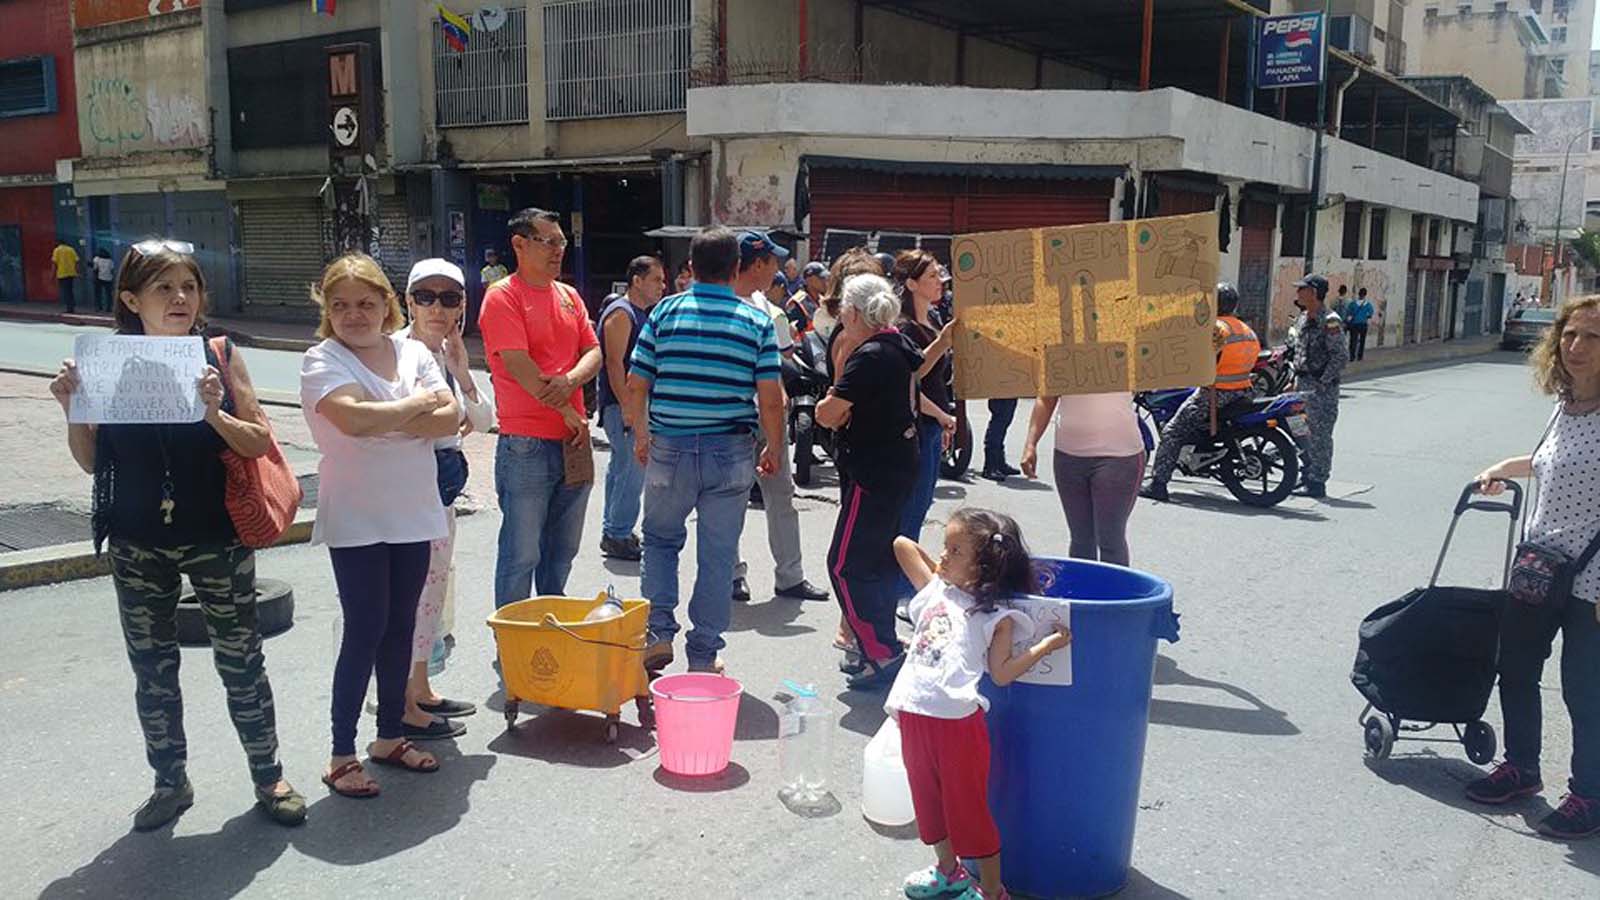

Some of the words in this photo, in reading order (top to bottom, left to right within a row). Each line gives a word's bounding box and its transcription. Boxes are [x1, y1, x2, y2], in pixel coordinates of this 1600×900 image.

[1263, 16, 1319, 35] PEPSI
[953, 221, 1184, 282] QUEREMOS
[1000, 336, 1191, 391] SIEMPRE
